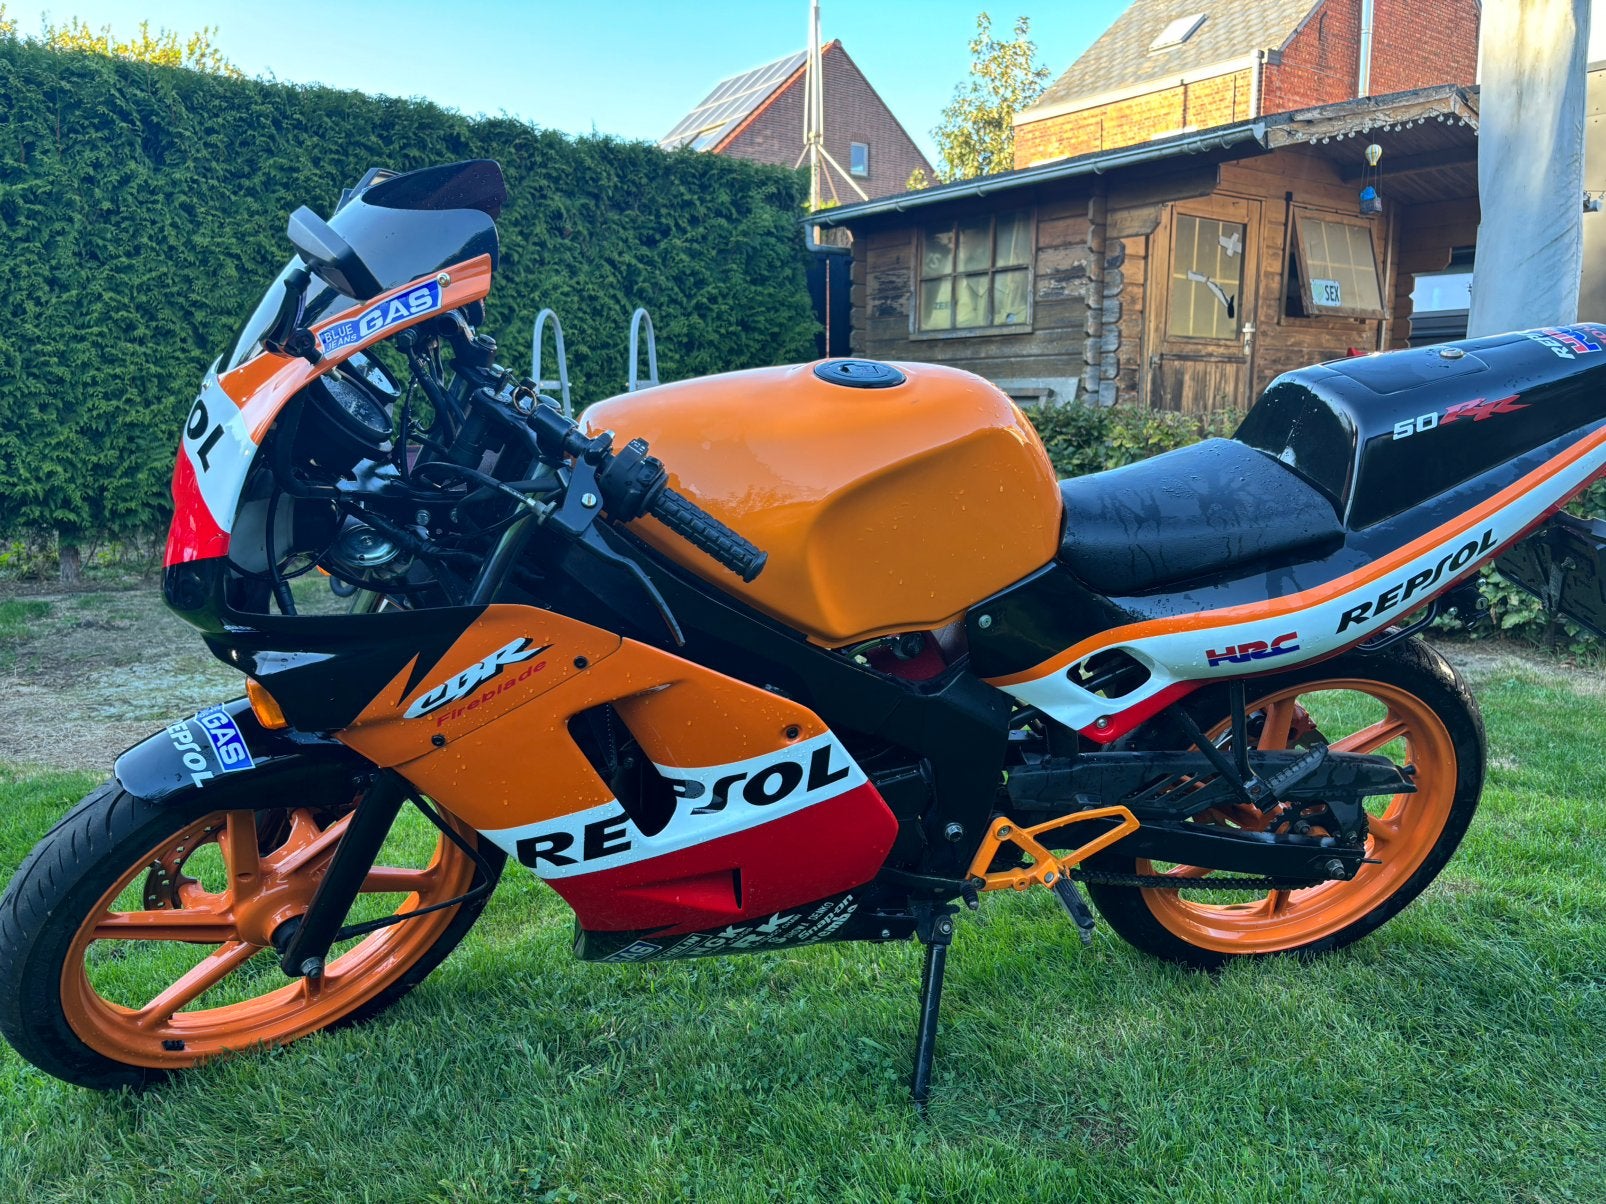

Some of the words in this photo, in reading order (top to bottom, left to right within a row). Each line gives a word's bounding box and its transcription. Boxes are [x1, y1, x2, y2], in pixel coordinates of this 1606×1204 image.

[359, 287, 433, 337] GAS
[1324, 285, 1340, 302] SEX
[324, 323, 354, 343] BLUE
[326, 333, 357, 351] JEANS
[1335, 528, 1498, 634] REPSOL
[1205, 631, 1301, 667] HRC
[402, 637, 552, 719] CBR
[436, 660, 547, 728] Fireblade
[166, 719, 214, 788] EPSOL
[201, 712, 246, 765] GAS
